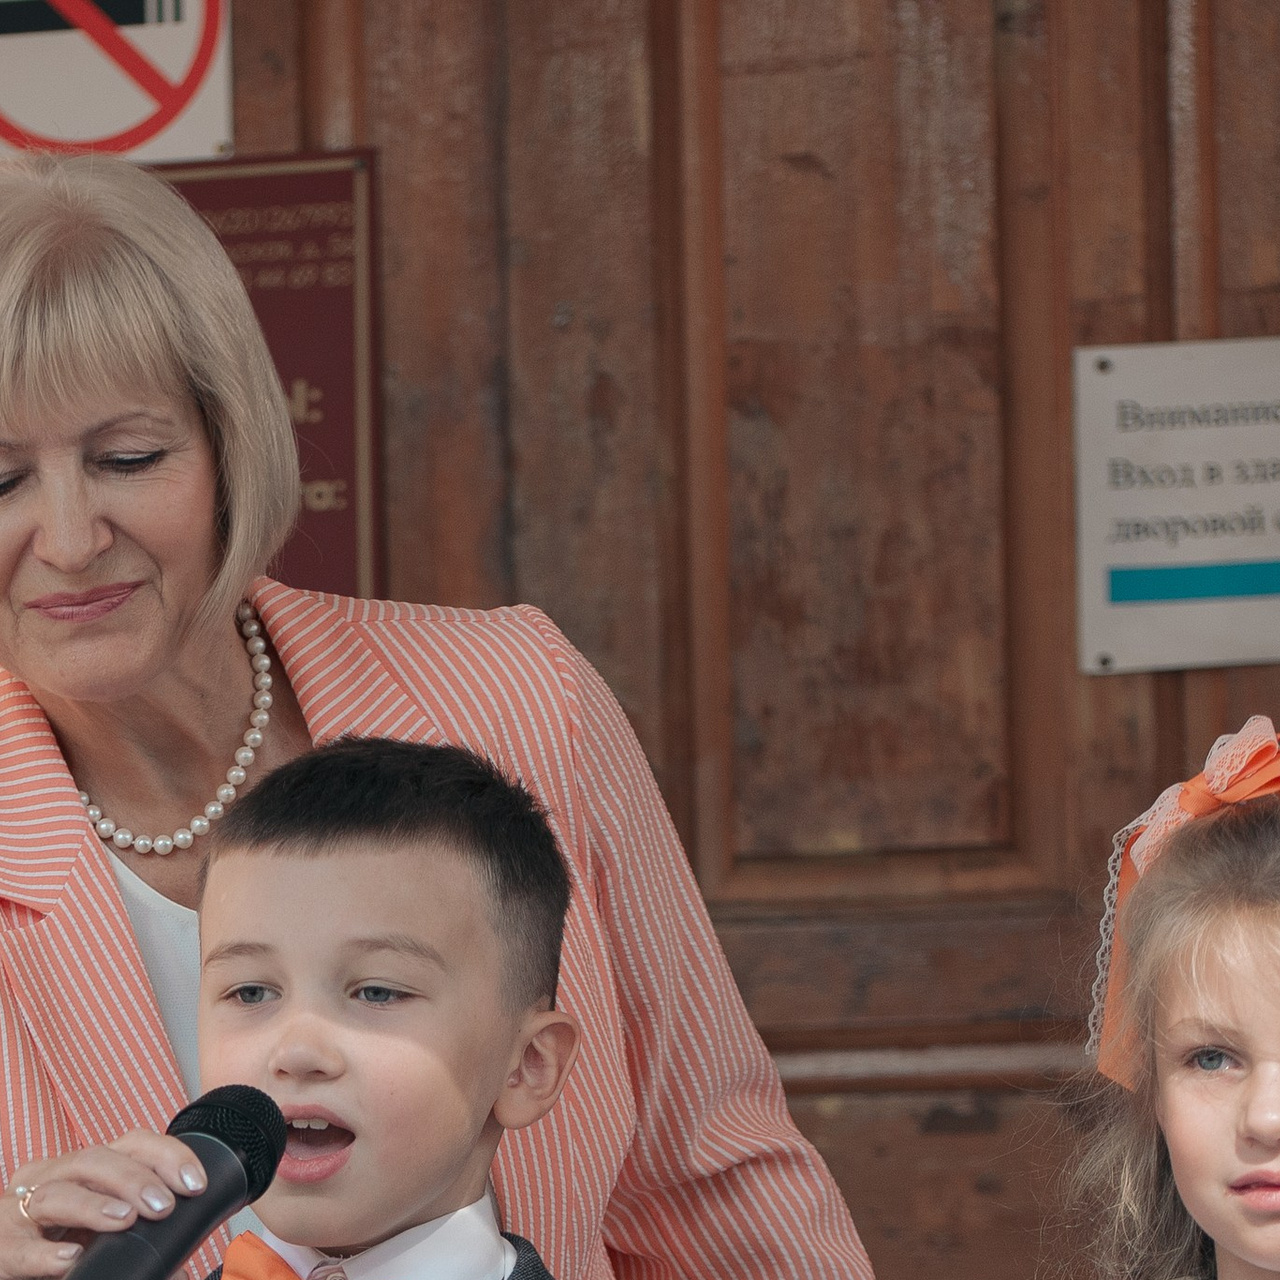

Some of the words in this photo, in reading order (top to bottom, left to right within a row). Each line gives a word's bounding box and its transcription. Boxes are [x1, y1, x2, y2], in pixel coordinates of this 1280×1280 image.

[1108, 457, 1197, 490] Вход
[1203, 461, 1223, 486] в
[1106, 503, 1266, 548] дворовой
